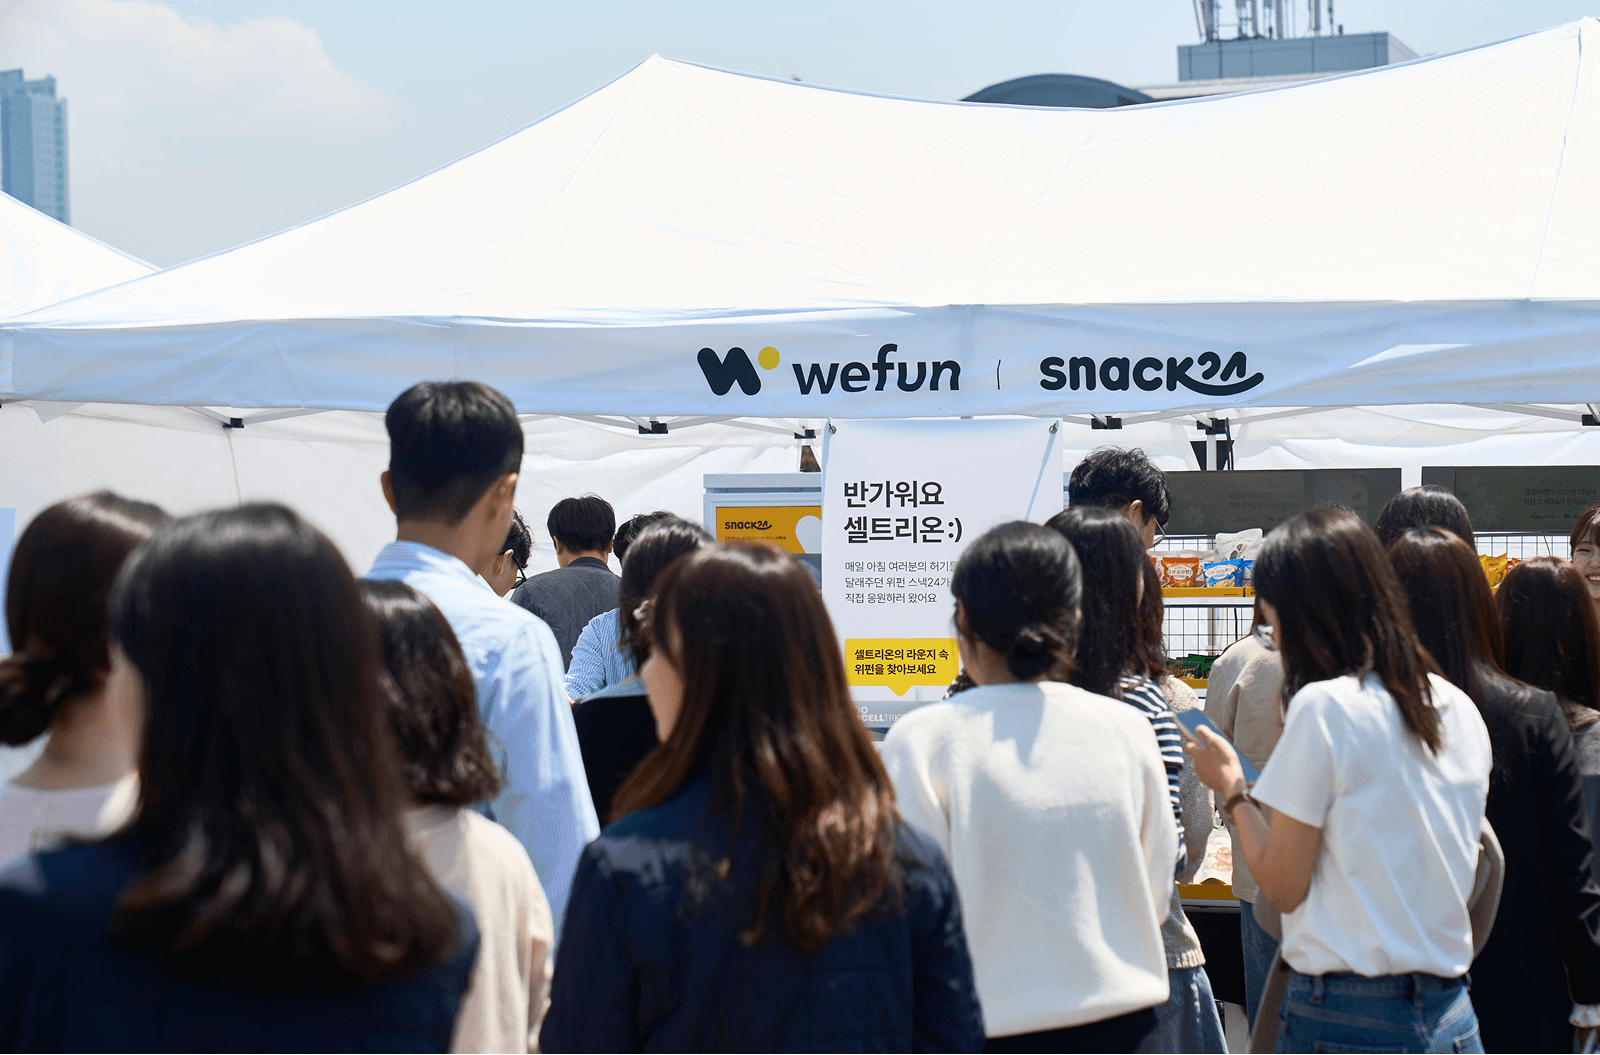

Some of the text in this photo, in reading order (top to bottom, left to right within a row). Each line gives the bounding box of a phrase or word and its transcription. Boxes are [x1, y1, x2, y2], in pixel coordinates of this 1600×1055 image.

[791, 343, 961, 396] wefun
[844, 480, 945, 508] 반가워요
[843, 515, 963, 544] 셀트리온:)
[844, 561, 864, 573] 매일
[866, 561, 886, 573] 아침
[888, 561, 927, 573] 여러분의
[845, 577, 951, 589] 달래주던 위펀 스낵24가
[845, 592, 938, 604] 직접 응원하러 왔어요
[854, 649, 949, 661] 셀트리온의 라운지 속
[854, 663, 937, 676] 위펀을 찾아보세요
